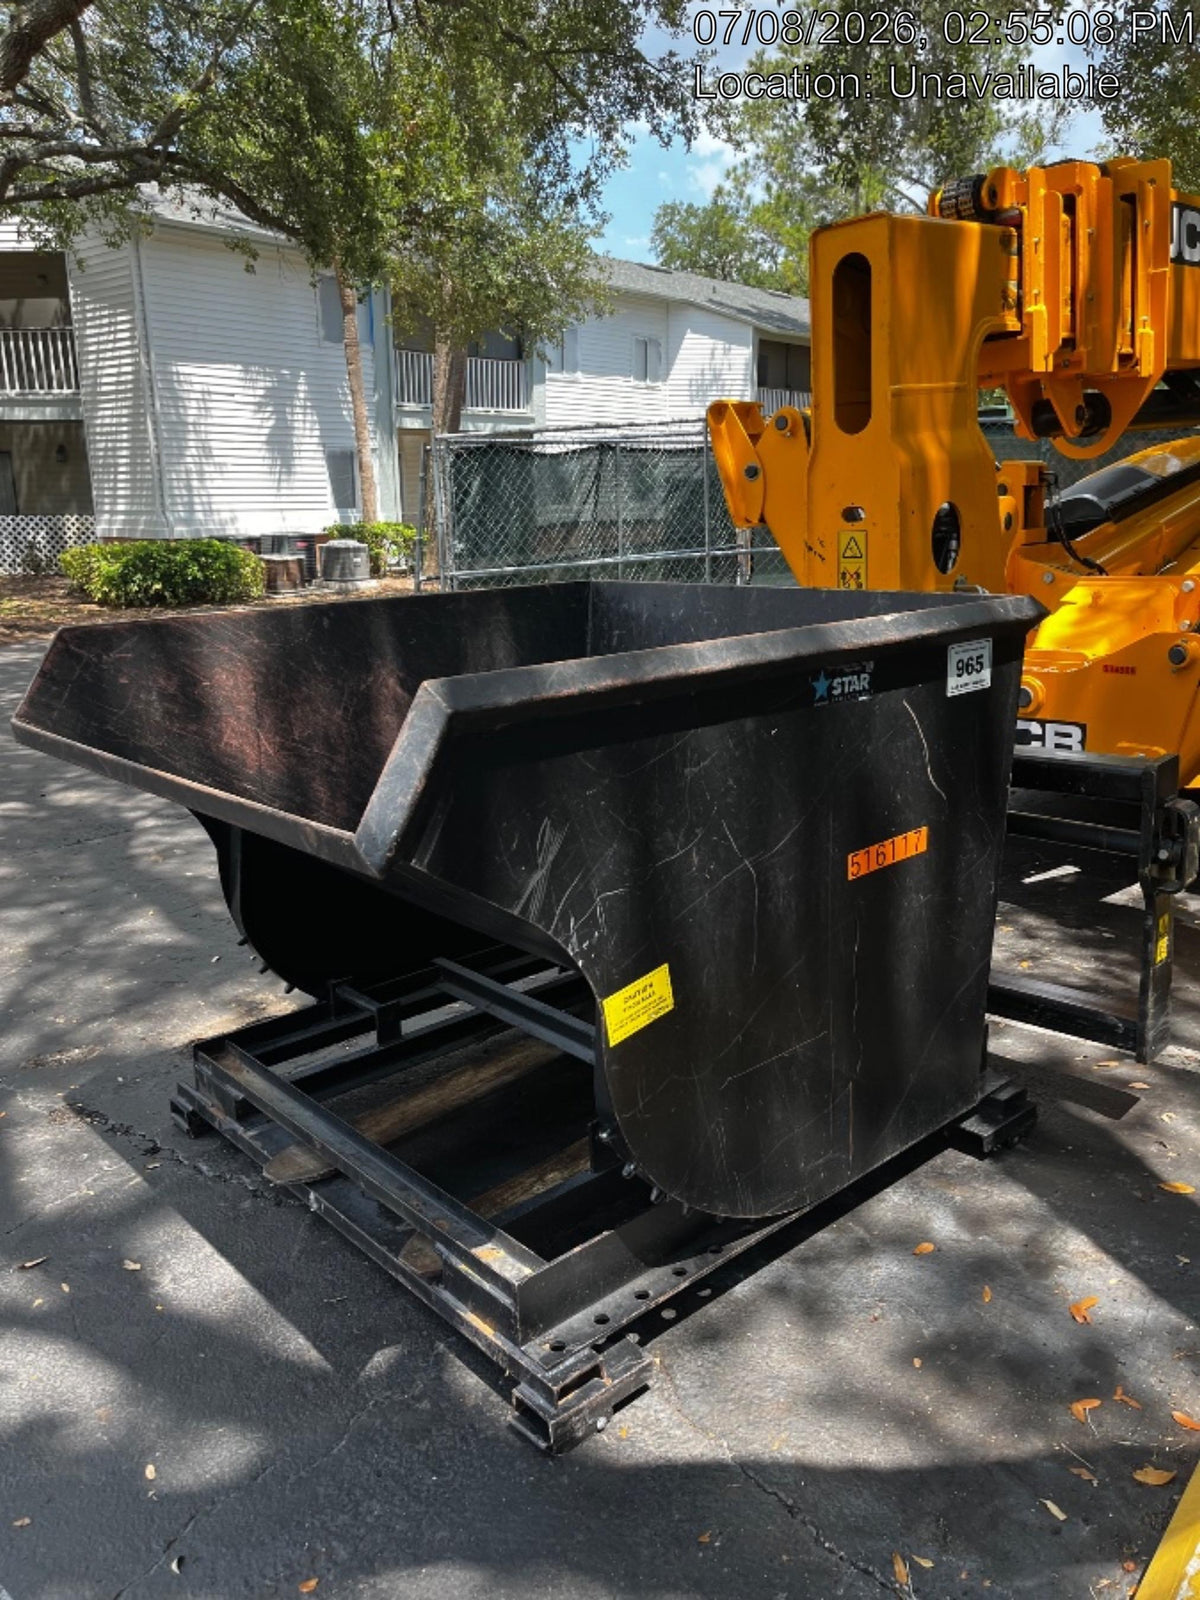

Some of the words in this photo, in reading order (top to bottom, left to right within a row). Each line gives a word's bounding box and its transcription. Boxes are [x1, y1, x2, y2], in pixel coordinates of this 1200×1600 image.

[956, 653, 984, 678] 965
[832, 673, 870, 696] STAR
[851, 829, 922, 877] 516117
